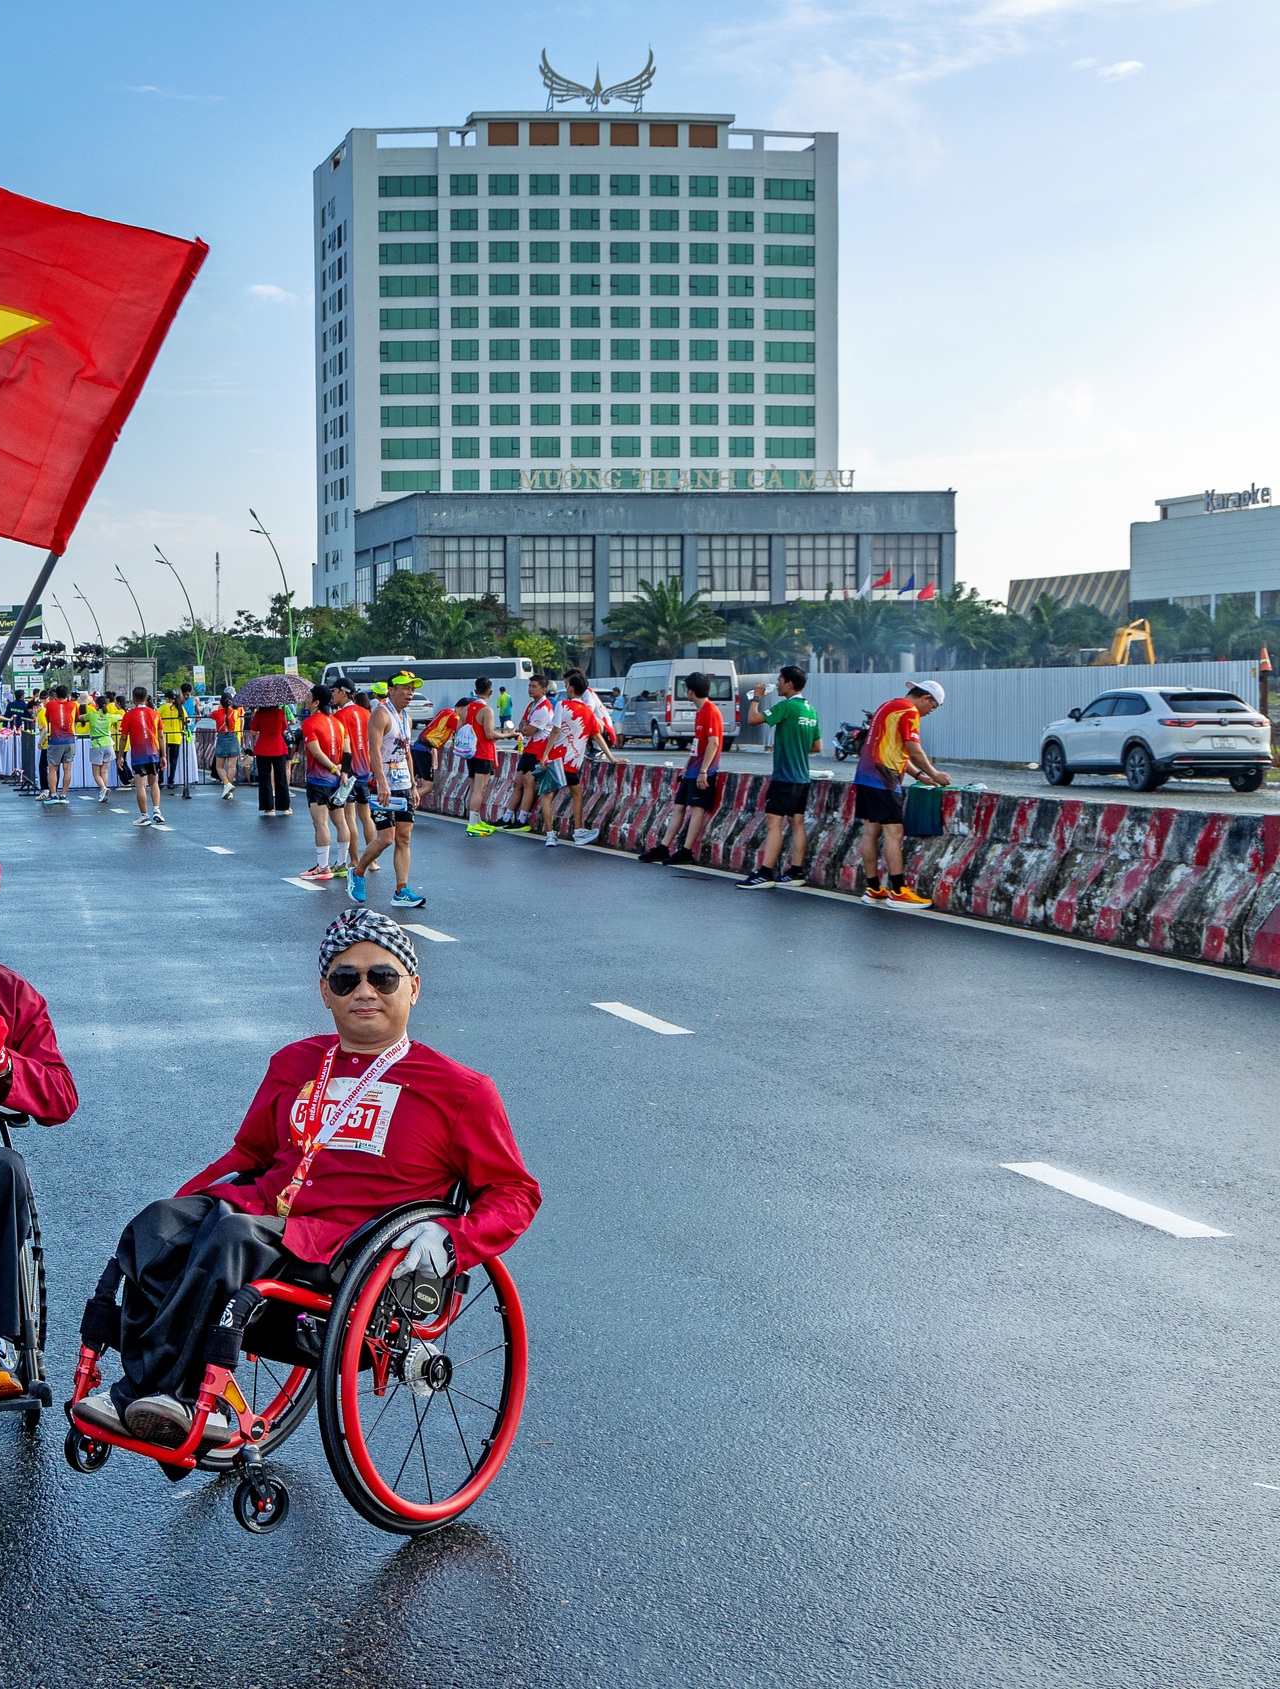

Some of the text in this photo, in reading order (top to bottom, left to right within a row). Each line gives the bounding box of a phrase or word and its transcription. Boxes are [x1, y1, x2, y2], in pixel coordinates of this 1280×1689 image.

[519, 463, 856, 489] MƯỜNG THANH CÀ MAU
[1205, 482, 1271, 511] Karaoke
[342, 1067, 378, 1109] MARATHON
[385, 1044, 402, 1059] MAU
